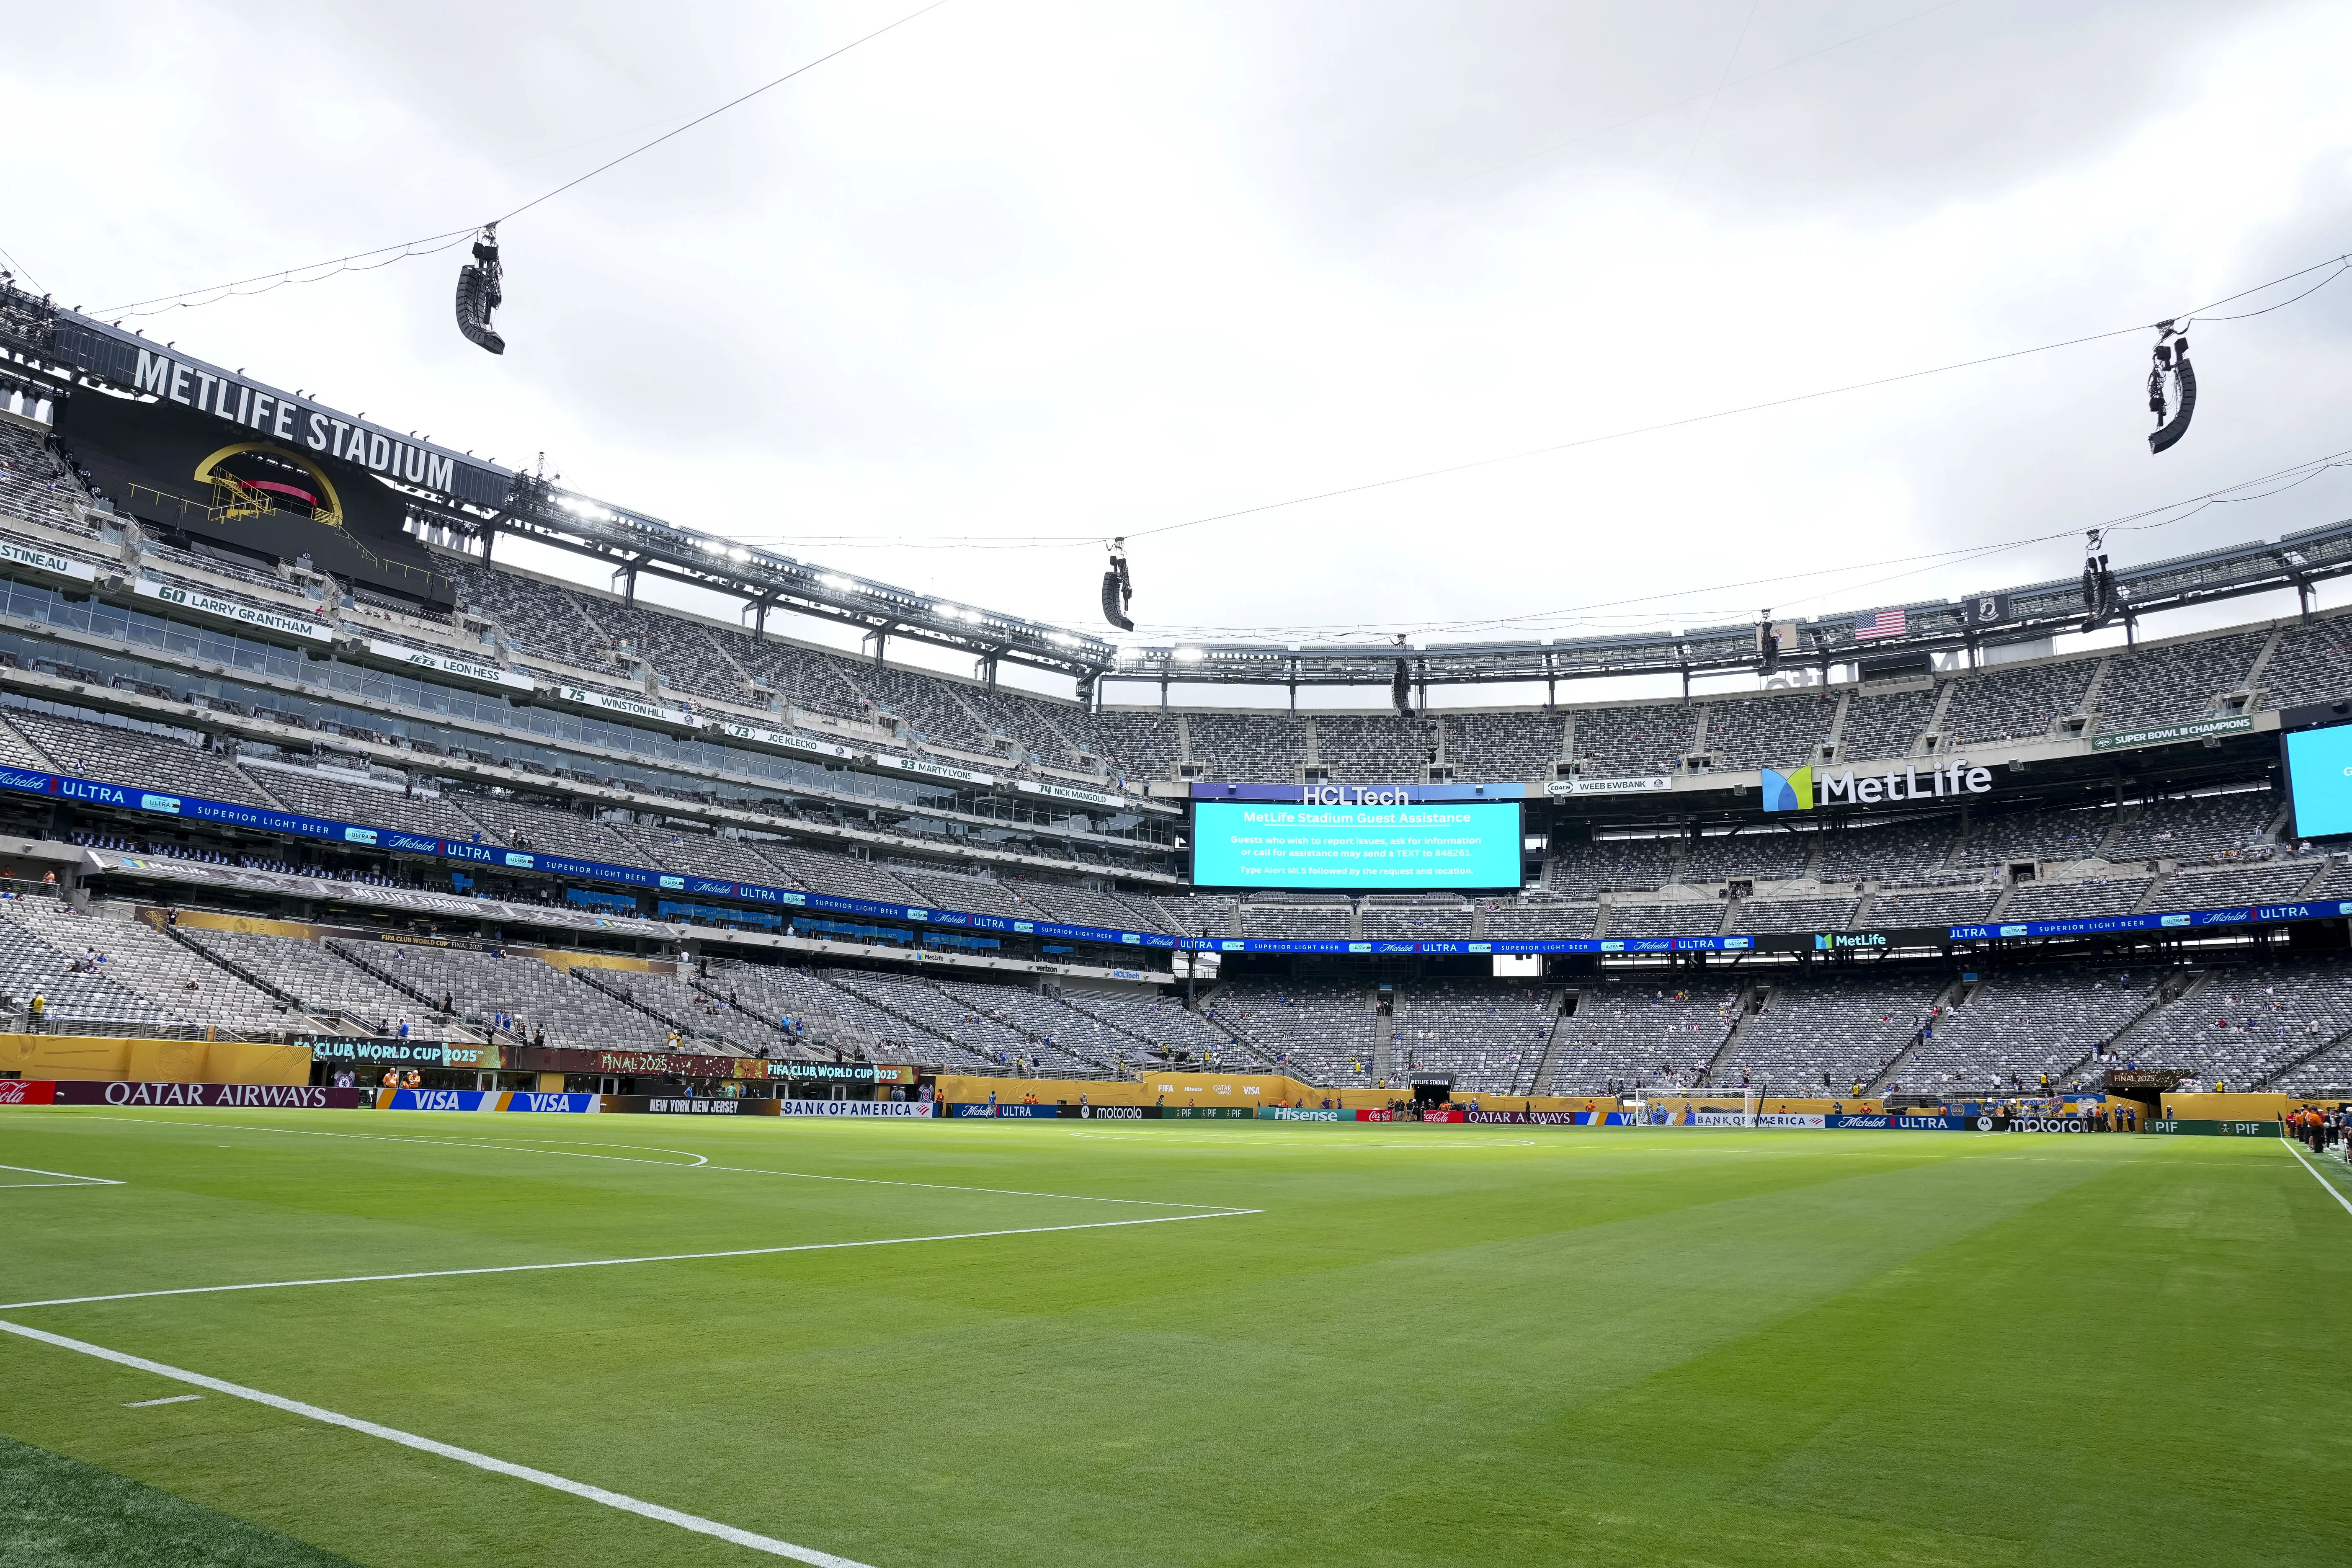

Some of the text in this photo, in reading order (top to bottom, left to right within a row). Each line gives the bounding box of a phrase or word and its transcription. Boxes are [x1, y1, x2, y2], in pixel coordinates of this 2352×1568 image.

[134, 348, 454, 493] METLIFE STADIUM
[159, 586, 312, 634] 60 LARRY GRANTHAM
[405, 655, 499, 680] JETS LEON HESS
[569, 689, 666, 718] 75 WINSTON HILL
[735, 726, 816, 749] 73 JOE KLECKO
[2115, 734, 2146, 744] SUPER
[2148, 730, 2178, 741] BOWL
[2189, 719, 2250, 734] CHAMPIONS
[901, 760, 972, 779] 93 MARTY LYONS
[1821, 759, 1992, 805] MetLife
[63, 782, 124, 803] ULTRA
[1039, 785, 1106, 802] 74 NICK MANGOLD
[1304, 785, 1408, 806] HCLTech
[150, 798, 170, 809] ULTRA
[198, 807, 328, 833] SUPERIOR LIGHT BEER
[1245, 812, 1470, 823] MetLife Stadium Guest Assistance
[389, 836, 490, 861] Michelob ULTRA
[149, 862, 209, 876] MetLife
[547, 862, 590, 873] SUPERIOR
[1240, 866, 1261, 874] Type
[1342, 867, 1359, 877] by
[1379, 868, 1409, 877] request
[694, 882, 775, 900] Michelob ULTRA
[351, 888, 481, 911] METLIFE STADIUM
[816, 900, 851, 909] SUPERIOR
[935, 913, 1004, 928] Michelob ULTRA
[2203, 907, 2308, 923] Michelob ULTRA
[612, 921, 653, 931] MetLife
[1836, 934, 1886, 946] MetLife
[315, 1042, 354, 1057] CLUB
[357, 1043, 407, 1059] WORLD
[416, 1047, 441, 1060] CUP
[602, 1055, 667, 1070] FINAL 2025
[768, 1065, 789, 1075] FIFA
[792, 1065, 816, 1077] CLUB
[818, 1067, 852, 1078] WORLD
[854, 1068, 873, 1079] CUP
[105, 1082, 326, 1106] QATAR AIRWAYS
[411, 1091, 459, 1109] VISA
[526, 1094, 569, 1112] VISA
[650, 1099, 738, 1113] NEW YORK NEW JERSEY
[785, 1102, 911, 1115] BANK OF AMERICA
[1003, 1106, 1031, 1116] ULTRA
[1097, 1108, 1142, 1119] motorola
[1275, 1108, 1337, 1121] Hisense
[1480, 1112, 1511, 1122] QATAR
[1839, 1117, 1947, 1128] Michelob ULTRA
[2156, 1122, 2178, 1132] PIF
[2236, 1124, 2259, 1134] PIF
